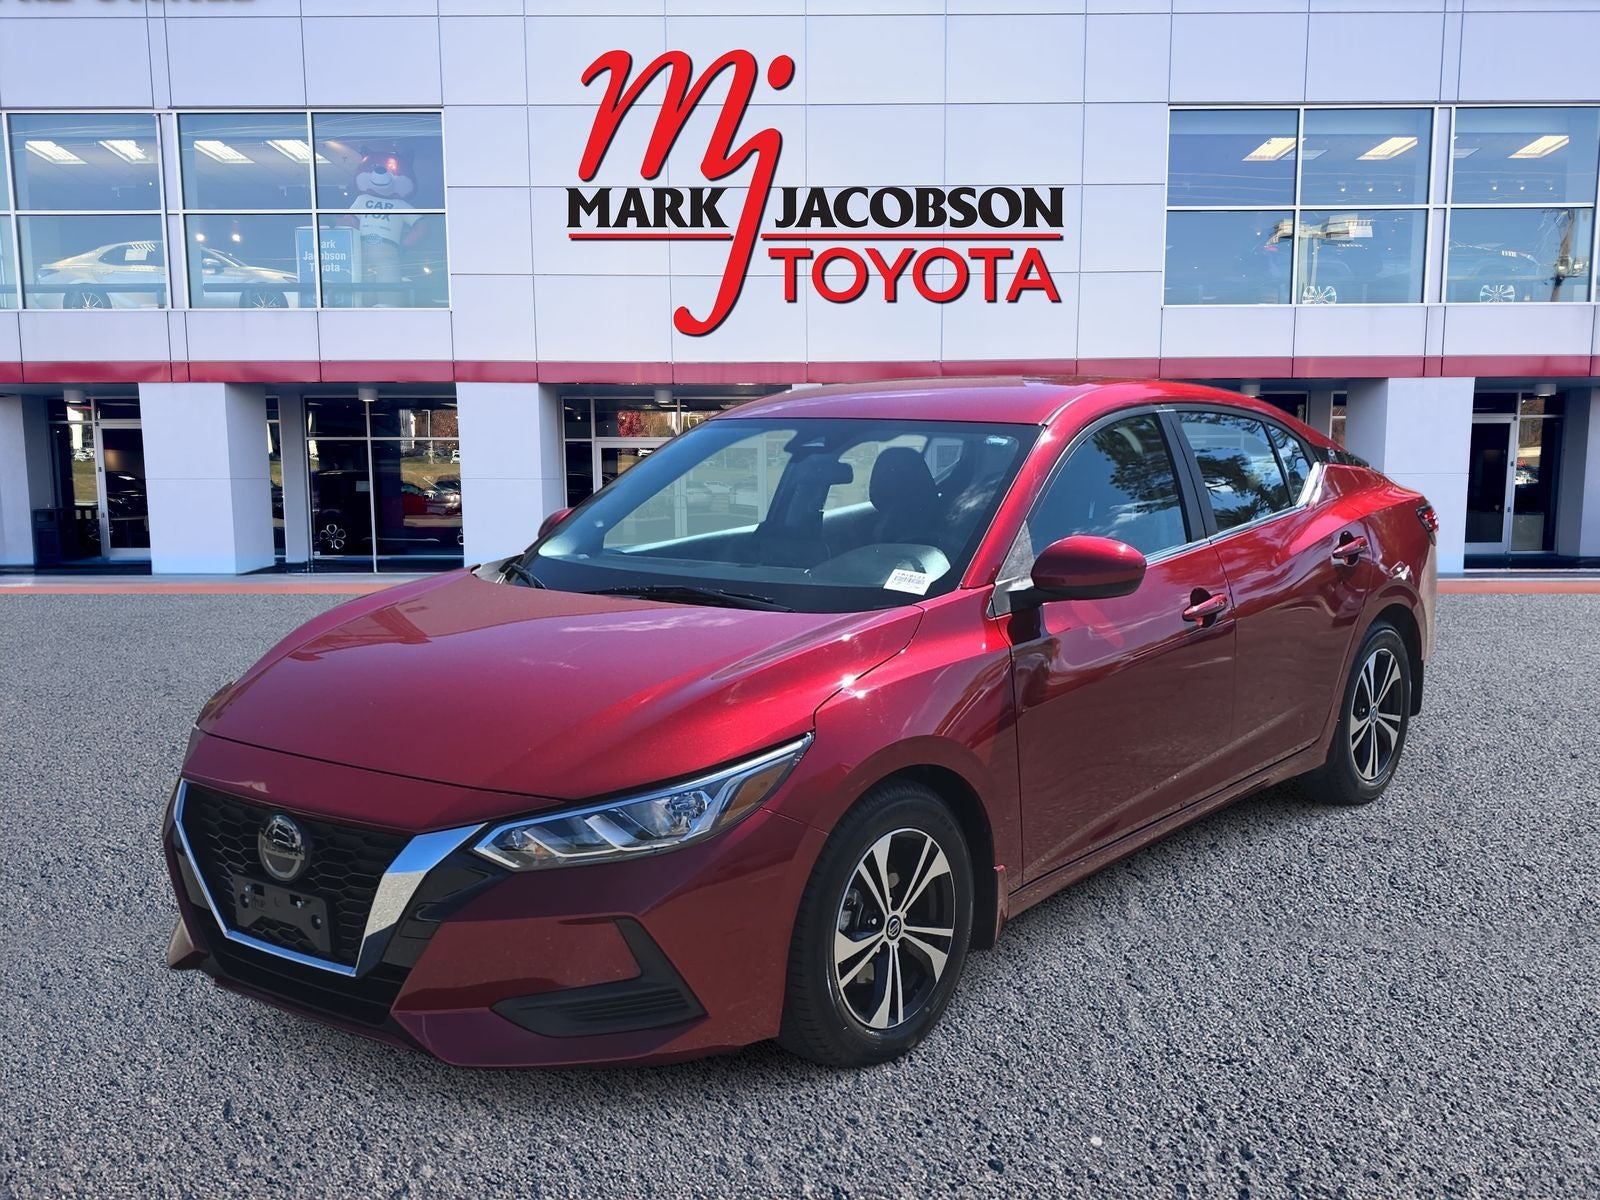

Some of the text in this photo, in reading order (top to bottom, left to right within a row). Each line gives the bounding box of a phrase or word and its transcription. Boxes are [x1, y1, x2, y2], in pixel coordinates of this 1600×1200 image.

[566, 186, 1065, 229] MARK JACOBSON
[767, 247, 1062, 304] TOYOTA
